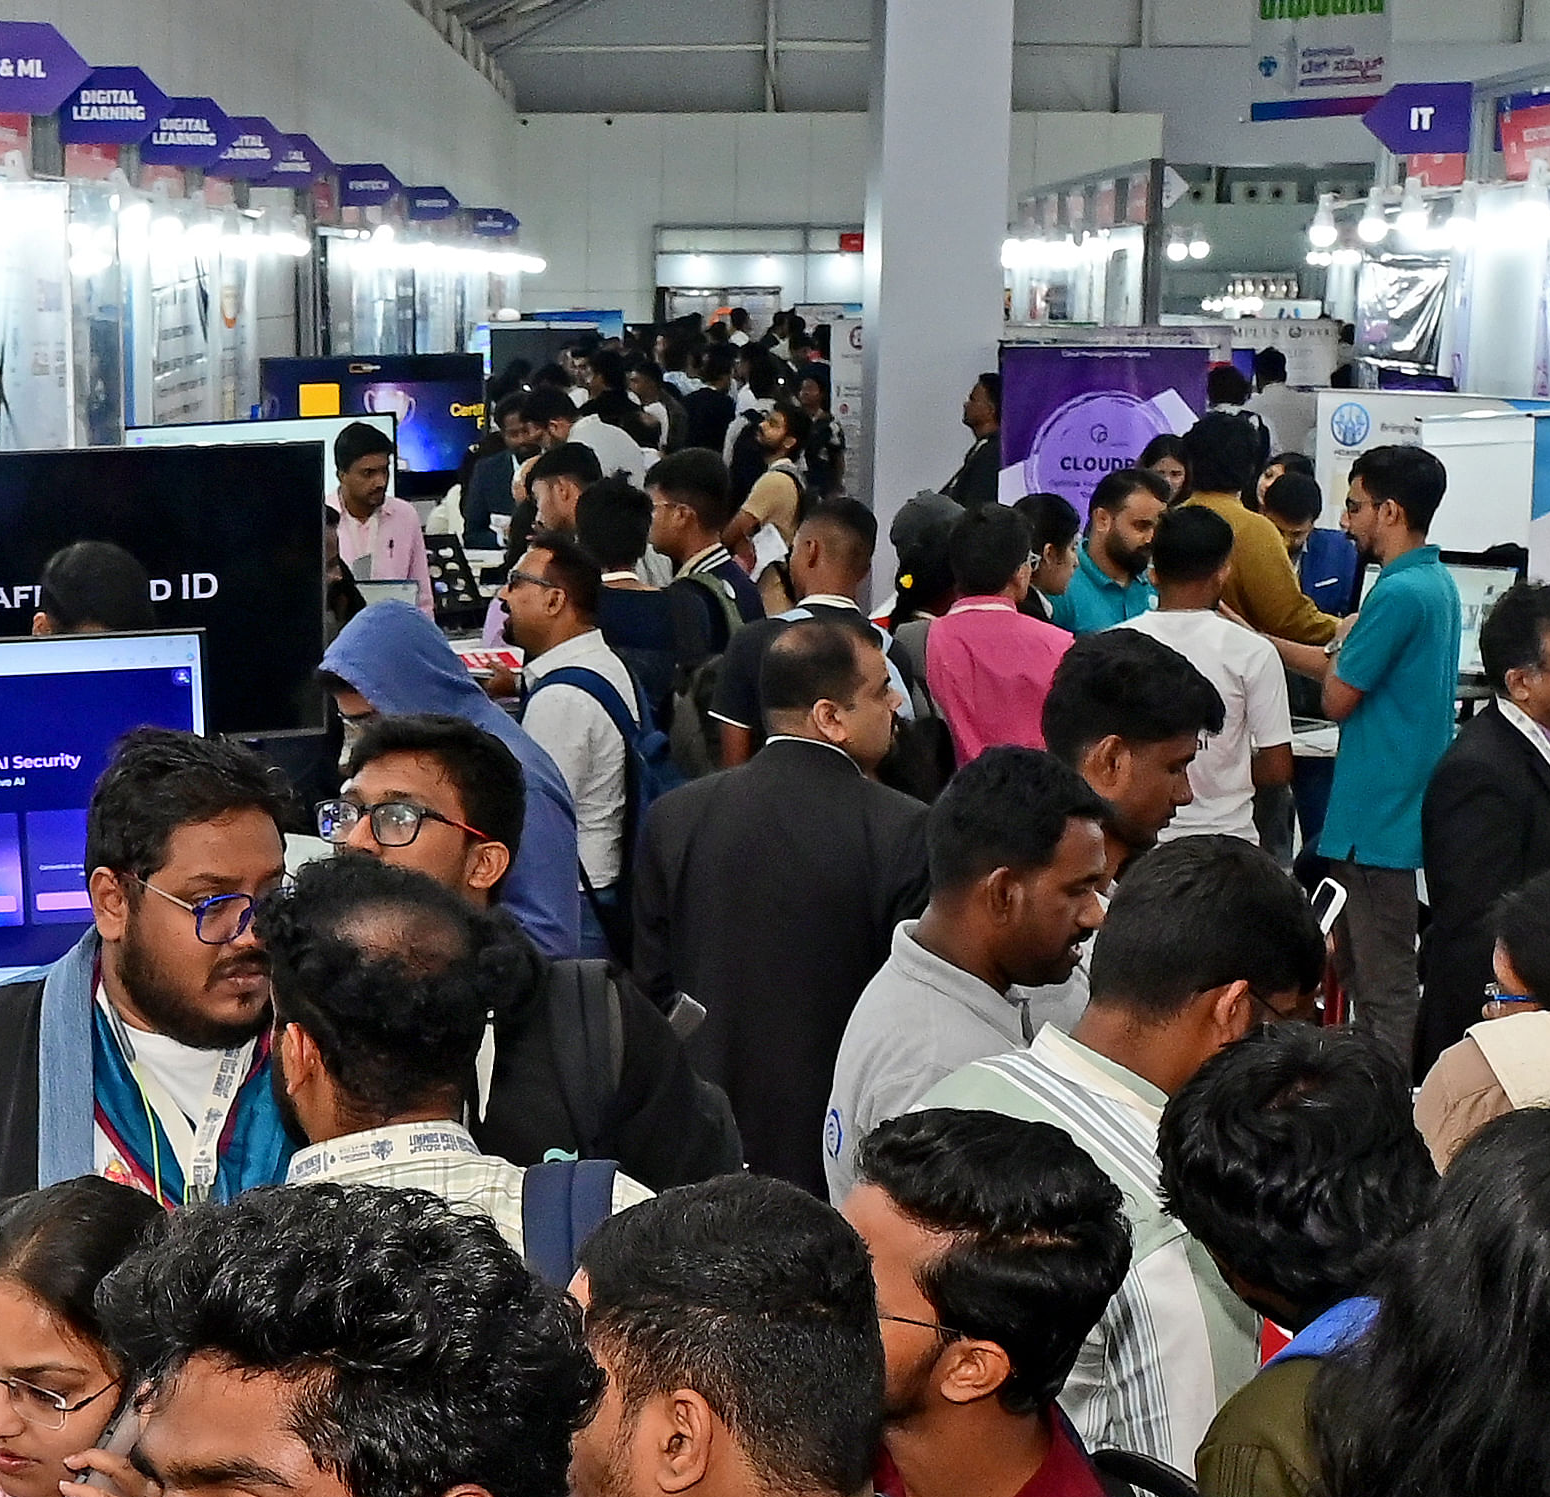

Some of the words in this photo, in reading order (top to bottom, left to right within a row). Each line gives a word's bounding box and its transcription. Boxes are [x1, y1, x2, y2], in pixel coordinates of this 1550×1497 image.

[17, 58, 47, 79] ML
[81, 89, 138, 105] DIGITAL
[72, 105, 146, 122] LEARNING
[1409, 106, 1436, 131] IT
[159, 117, 210, 133] DIGITAL
[152, 131, 217, 147] LEARNING
[11, 752, 83, 771] Security
[12, 776, 27, 787] AI
